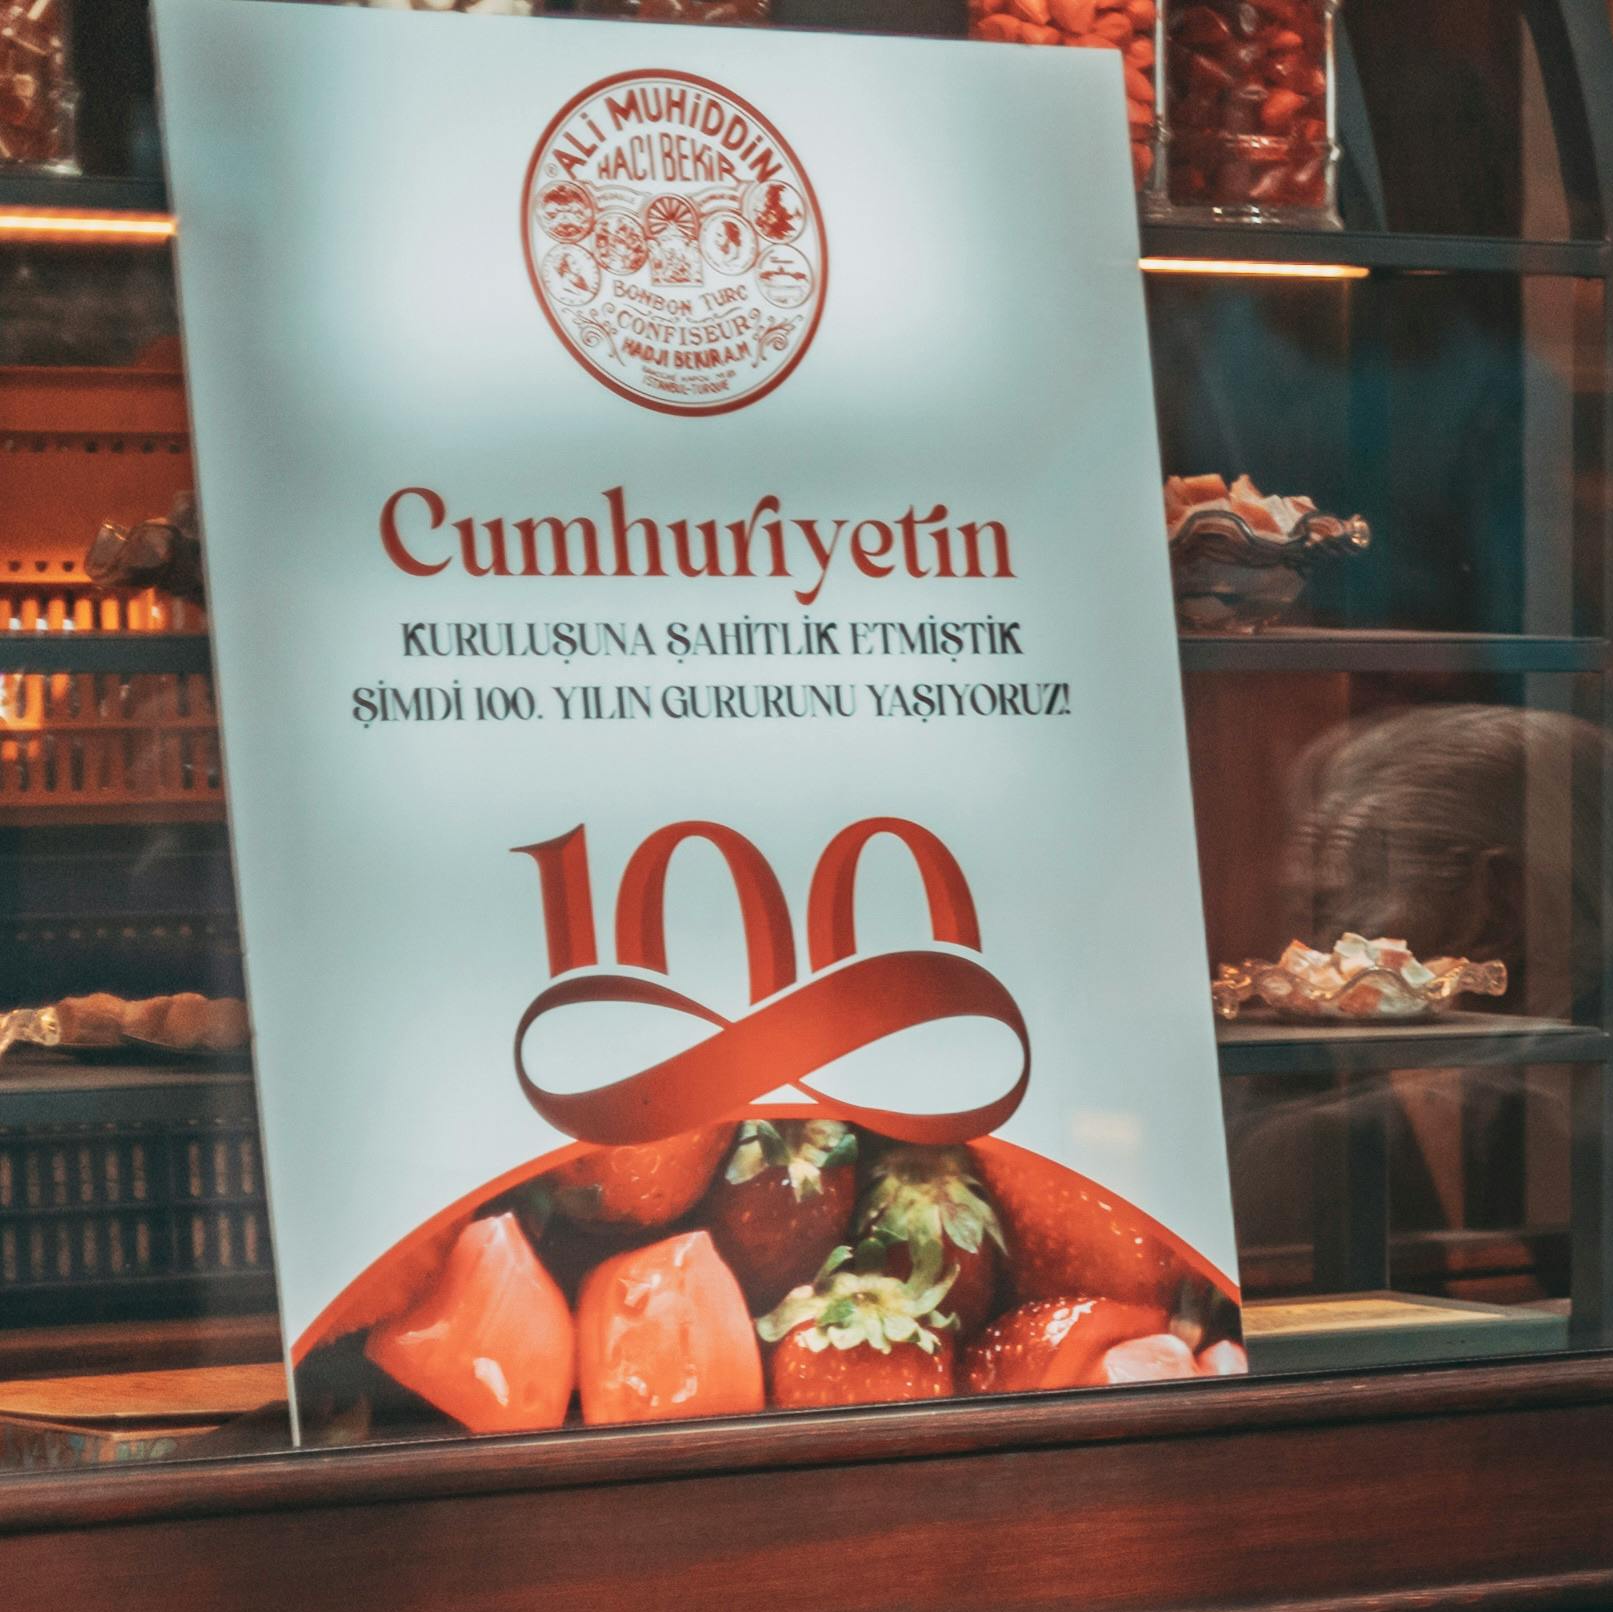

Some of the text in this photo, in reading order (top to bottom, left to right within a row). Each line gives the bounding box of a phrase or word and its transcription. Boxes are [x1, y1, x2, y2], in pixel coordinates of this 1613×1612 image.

[597, 134, 657, 181] HACI
[613, 280, 748, 316] BONBON TURC
[617, 310, 751, 346] CONFISEUR
[622, 337, 669, 367] HADJI
[379, 485, 1017, 606] Cumhuriyetin
[401, 615, 1024, 664] KURULUŞUNA ŞAHİTLİK ETMİŞTİK
[352, 679, 1071, 729] ŞİMDİ 100. YILIN GURURUNU YAŞIYORUZ!
[508, 815, 984, 1008] 100
